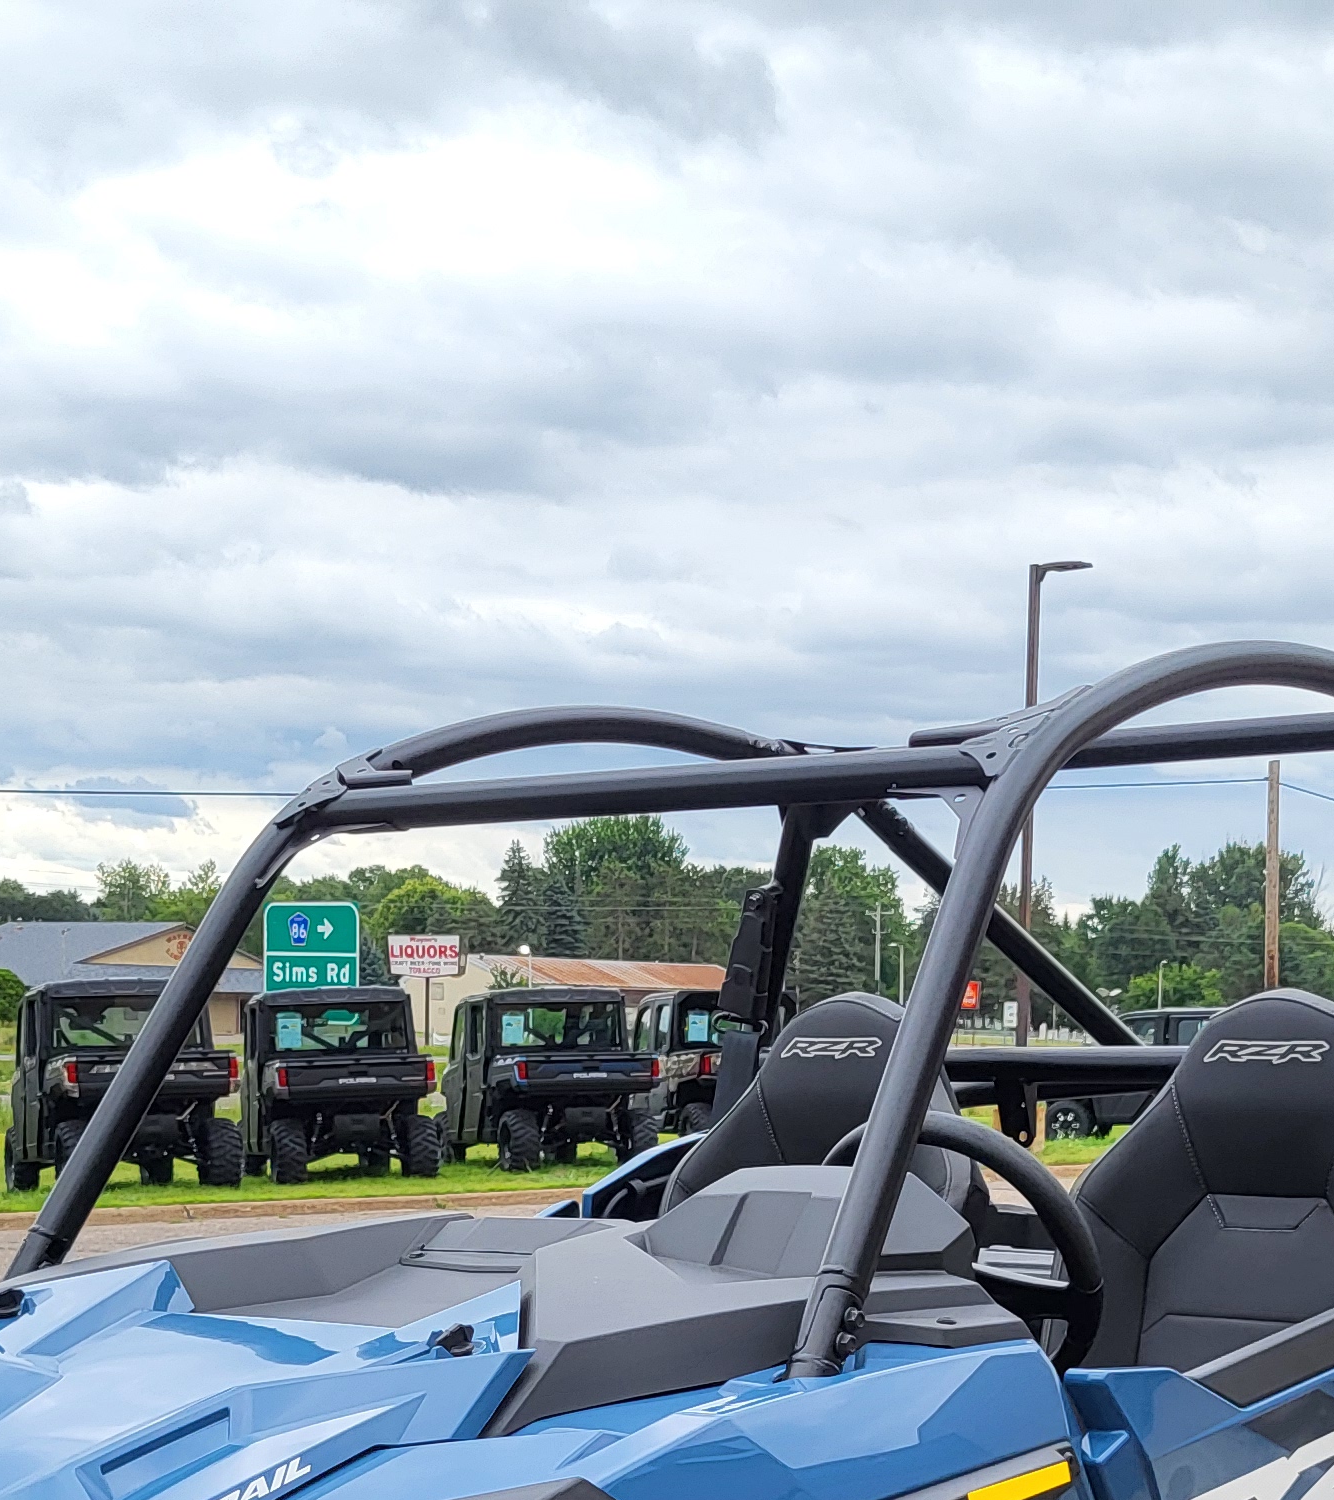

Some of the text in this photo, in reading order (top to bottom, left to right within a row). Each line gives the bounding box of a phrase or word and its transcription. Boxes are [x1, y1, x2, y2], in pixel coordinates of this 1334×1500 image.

[292, 923, 307, 939] 86
[390, 944, 458, 959] LIQUORS
[273, 961, 350, 983] Sims Rd
[780, 1037, 883, 1059] RZR
[1203, 1040, 1330, 1064] RZR
